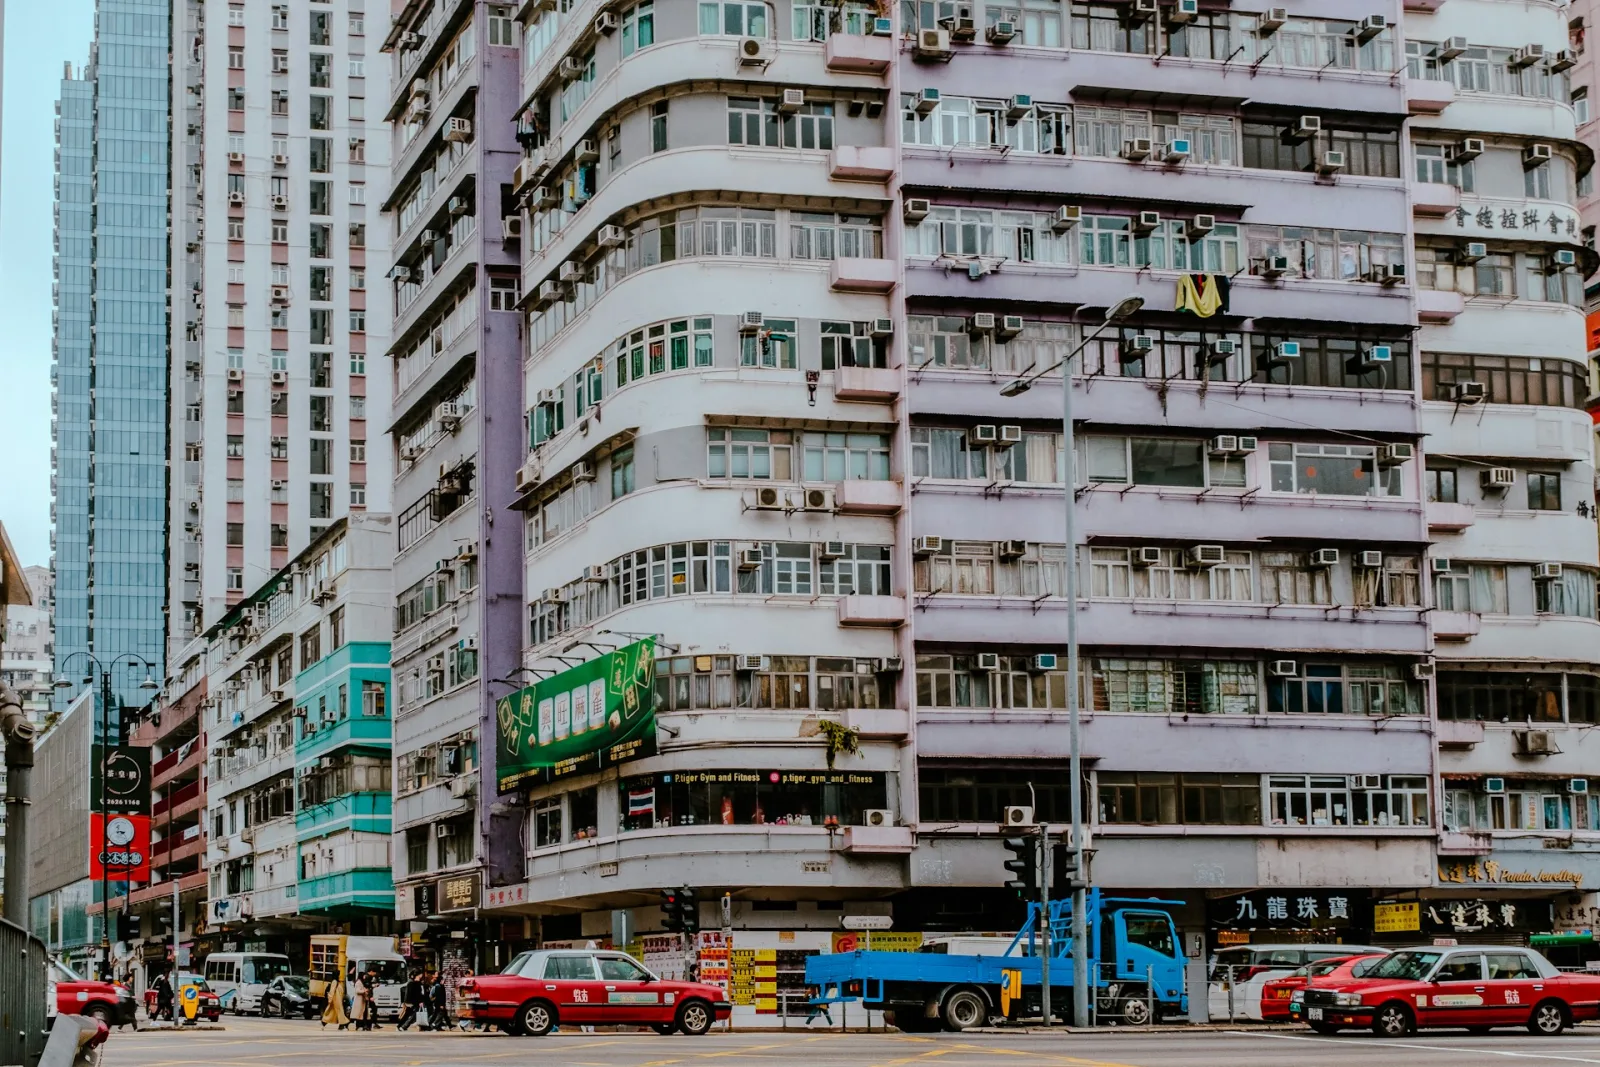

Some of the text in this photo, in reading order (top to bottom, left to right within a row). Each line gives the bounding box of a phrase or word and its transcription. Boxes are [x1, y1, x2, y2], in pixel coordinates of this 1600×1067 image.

[675, 773, 760, 784] P.tiger Gym and Fitness
[782, 773, 873, 784] p.tiger_gym_and_fitness
[1501, 869, 1533, 882] Panda
[1534, 868, 1584, 889] Jewellery
[1236, 896, 1349, 920] 九龍珠寶
[1423, 904, 1516, 927] 八達珠寶
[1505, 996, 1520, 1004] TAXI
